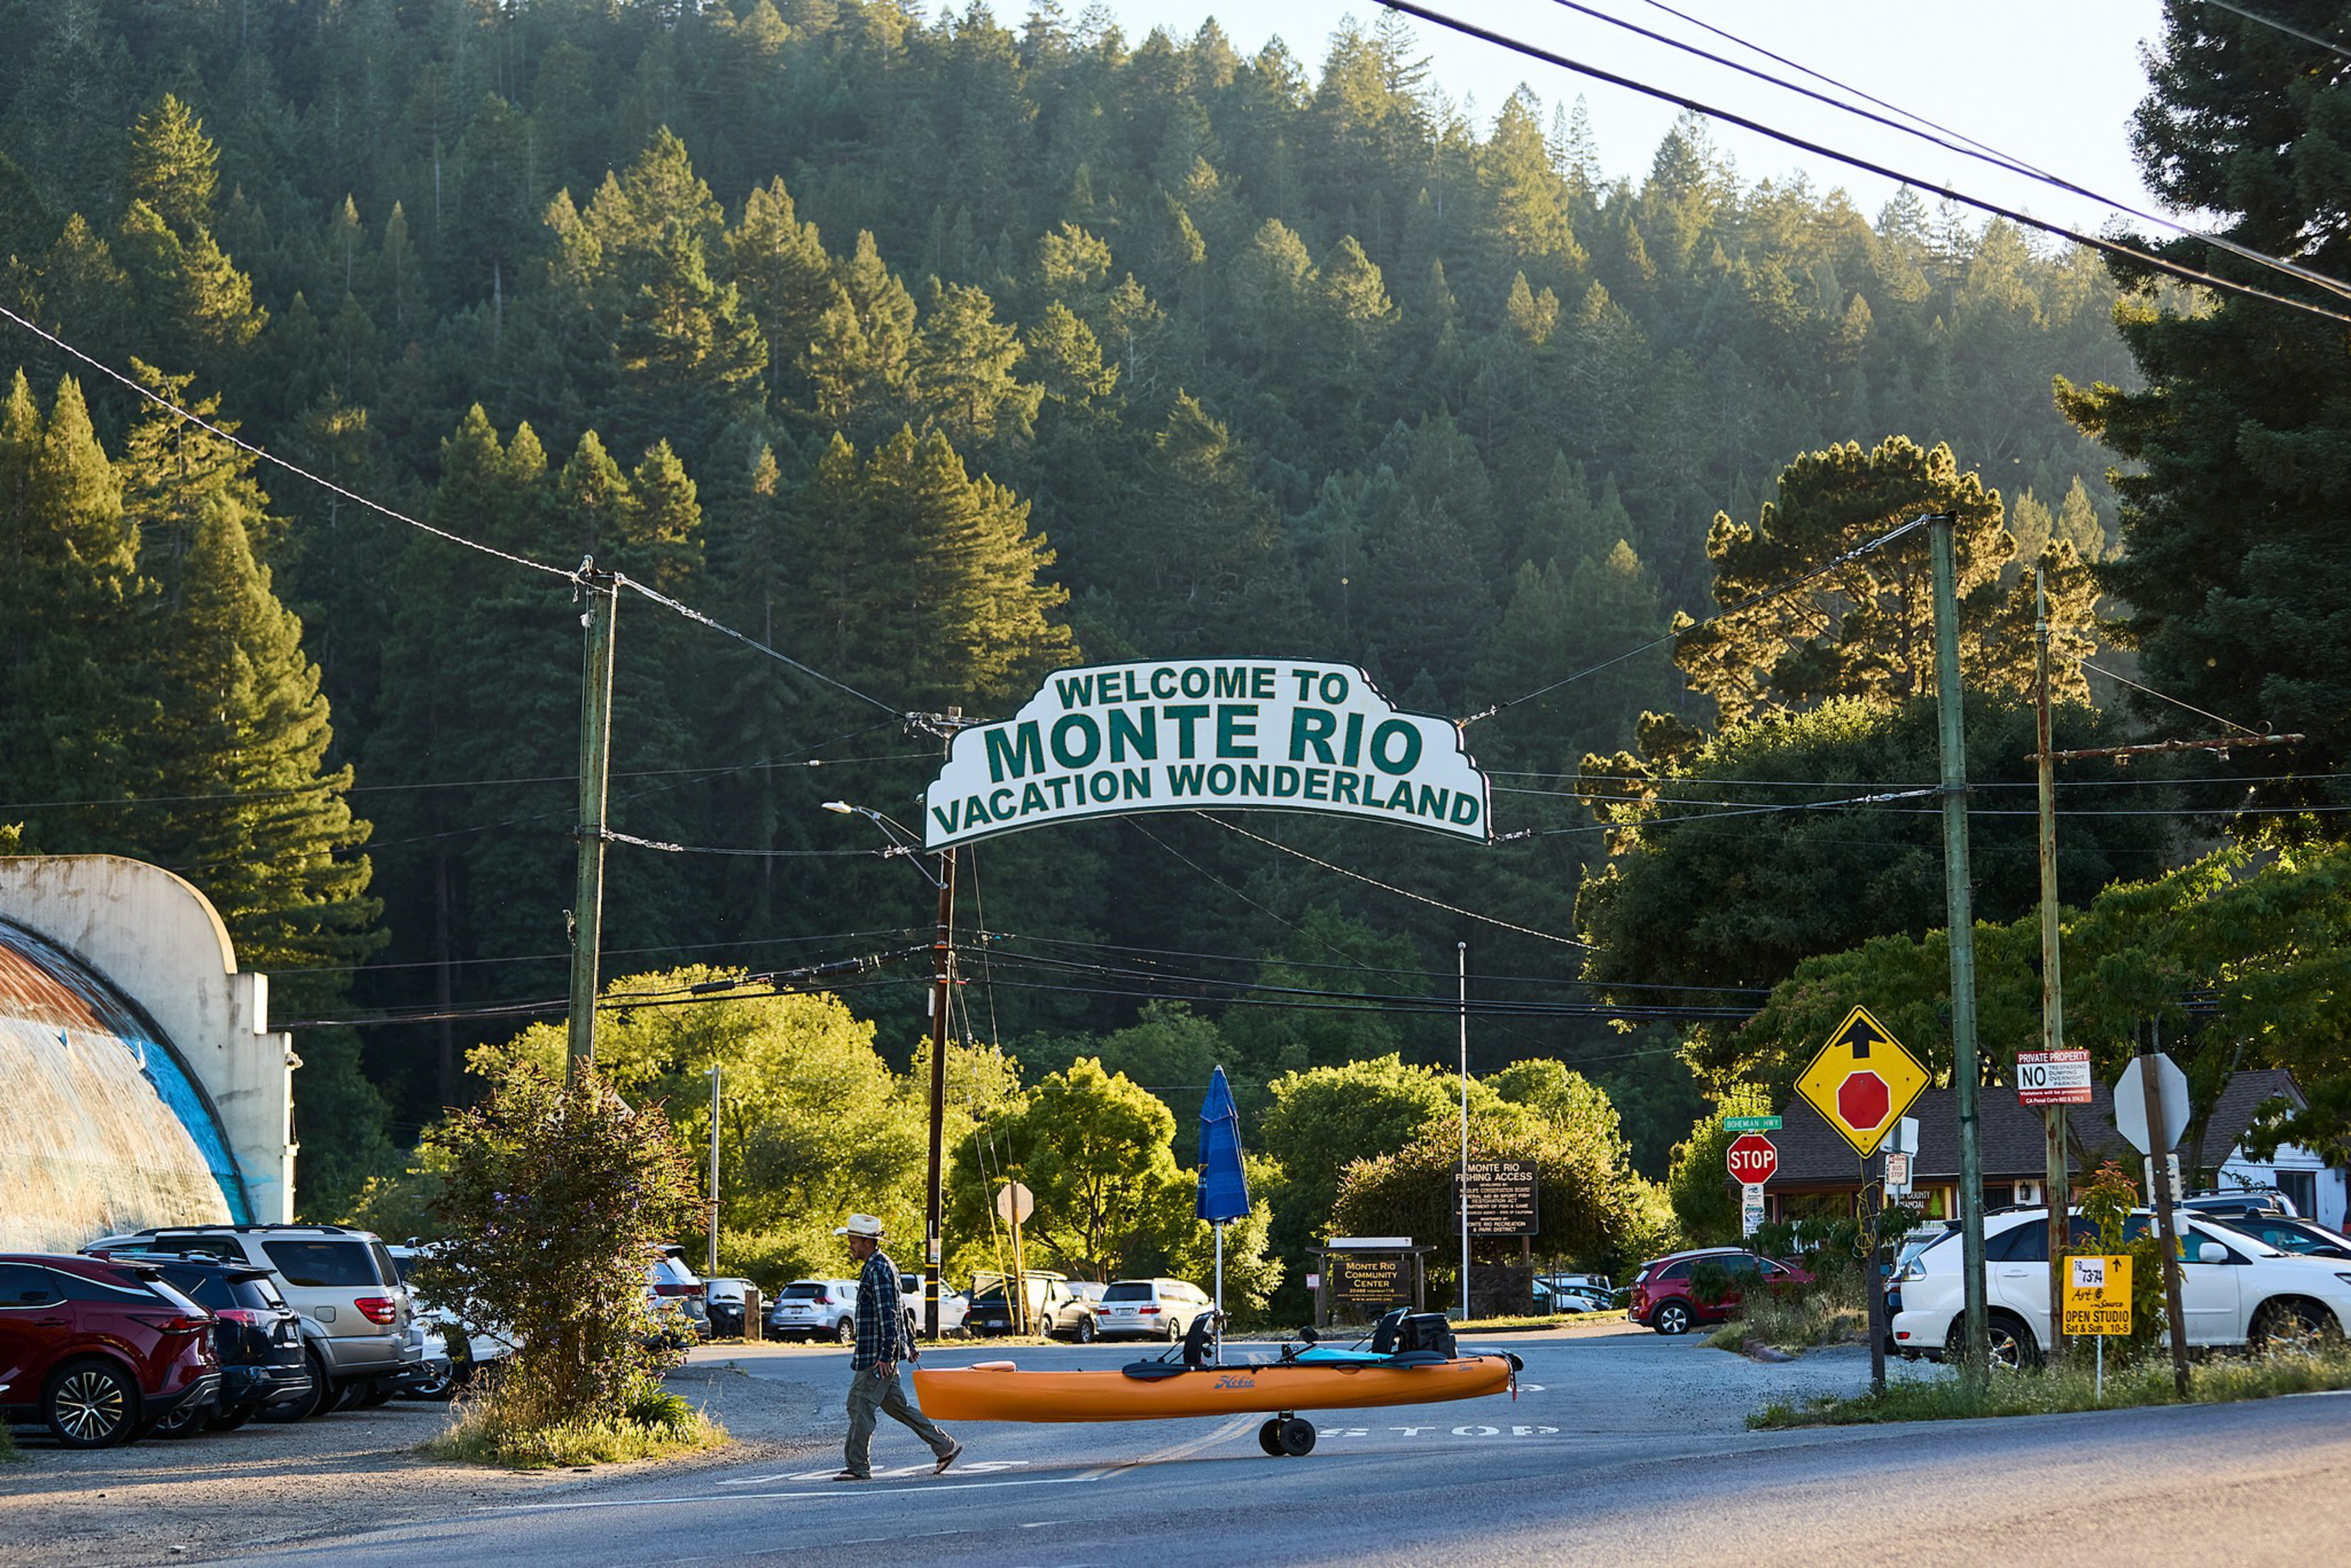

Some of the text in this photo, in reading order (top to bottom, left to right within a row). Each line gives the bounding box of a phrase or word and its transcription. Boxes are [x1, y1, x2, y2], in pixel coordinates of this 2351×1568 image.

[1056, 667, 1349, 710] WELCOME TO
[984, 704, 1423, 784] MONTE RIO
[931, 763, 1480, 836] VACATION WONDERLAND
[2019, 1051, 2088, 1063] PRIVATE PROPERTY
[2022, 1066, 2046, 1087] NO
[1727, 1120, 1759, 1128] BOHEMIAN
[1730, 1150, 1774, 1169] STOP
[1468, 1163, 1520, 1172] MONTE RIO
[1494, 1172, 1533, 1182] ACCESS
[1907, 1191, 1931, 1199] COUNTY
[1380, 1262, 1396, 1270] RIO
[2071, 1289, 2093, 1301] Art
[2066, 1310, 2129, 1322] OPEN STUDIO
[2066, 1324, 2129, 1333] Sat & Sun 10-5
[1213, 1375, 1256, 1389] Hobie
[1317, 1425, 1561, 1438] STOP
